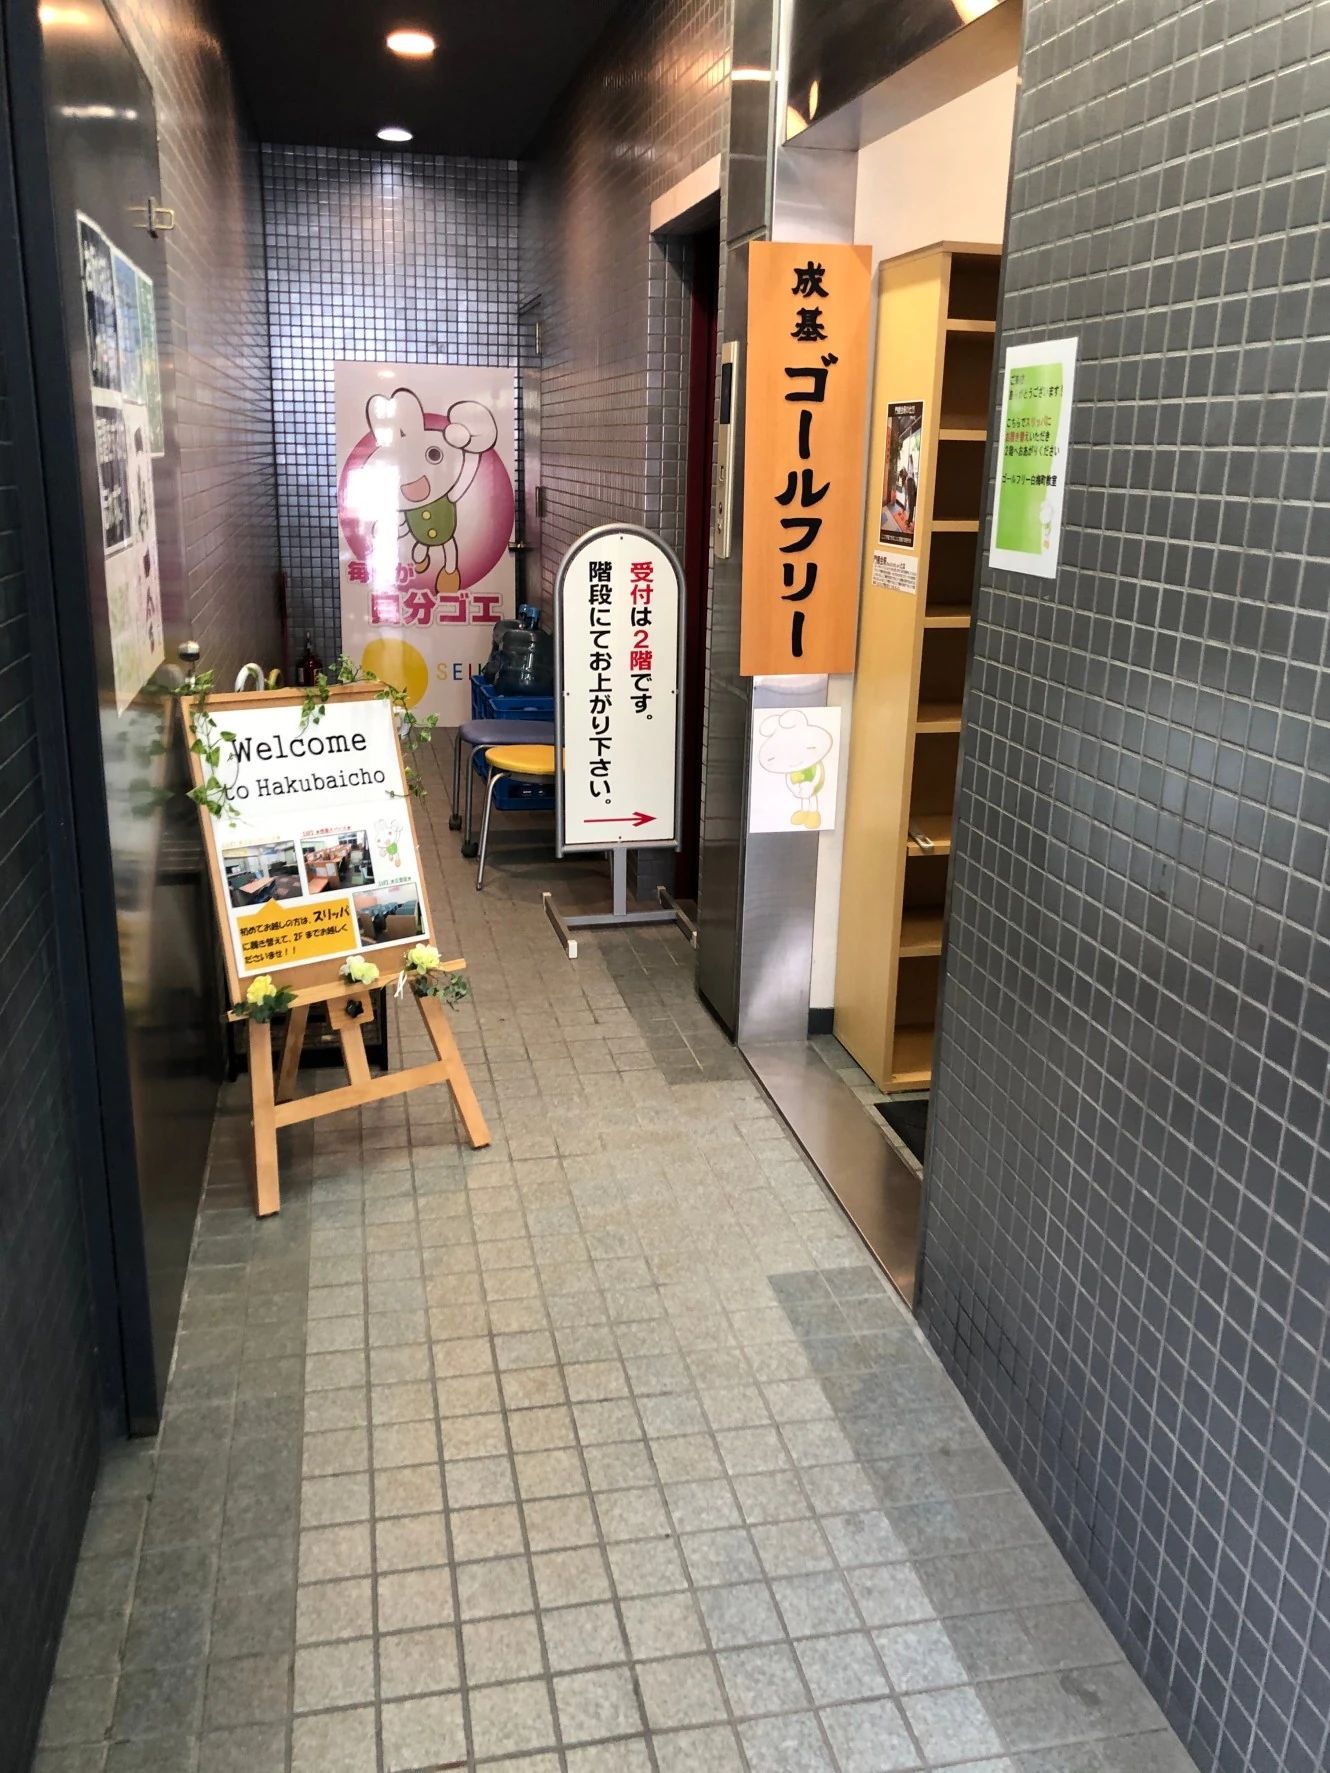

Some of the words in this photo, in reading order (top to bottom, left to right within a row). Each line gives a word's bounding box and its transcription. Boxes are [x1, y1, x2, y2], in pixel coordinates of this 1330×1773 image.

[774, 261, 839, 658] 成基ゴールフリー
[347, 561, 415, 584] 毎が
[588, 561, 613, 805] 階段にてお上がり下さい。
[630, 561, 654, 720] 受付は2階です。
[225, 784, 249, 801] to
[256, 768, 385, 797] Hakubaicho
[232, 732, 367, 763] Welcome
